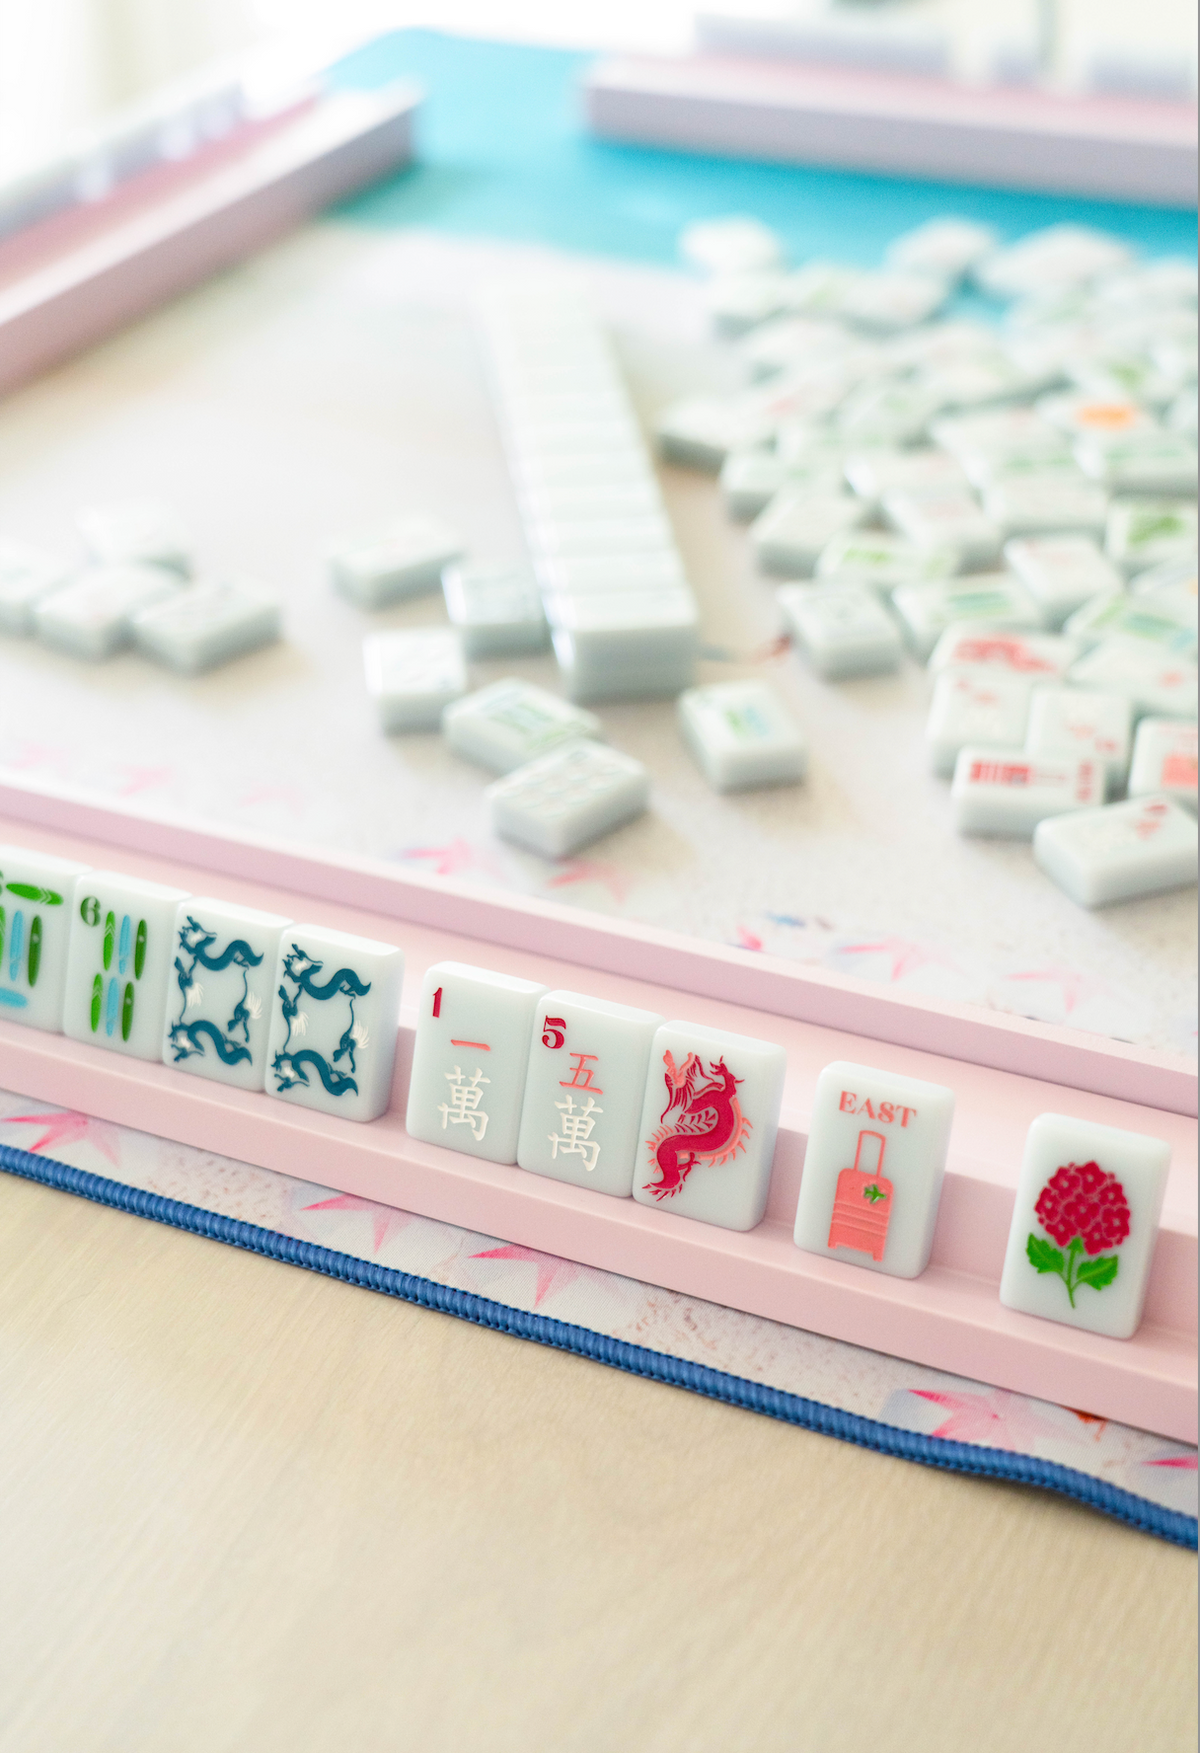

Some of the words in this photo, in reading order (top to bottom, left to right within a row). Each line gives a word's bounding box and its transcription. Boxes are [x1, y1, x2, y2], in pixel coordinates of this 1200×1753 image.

[80, 895, 101, 928] 6
[432, 986, 443, 1019] 1
[541, 1015, 567, 1050] 5
[838, 1090, 917, 1129] EAST
